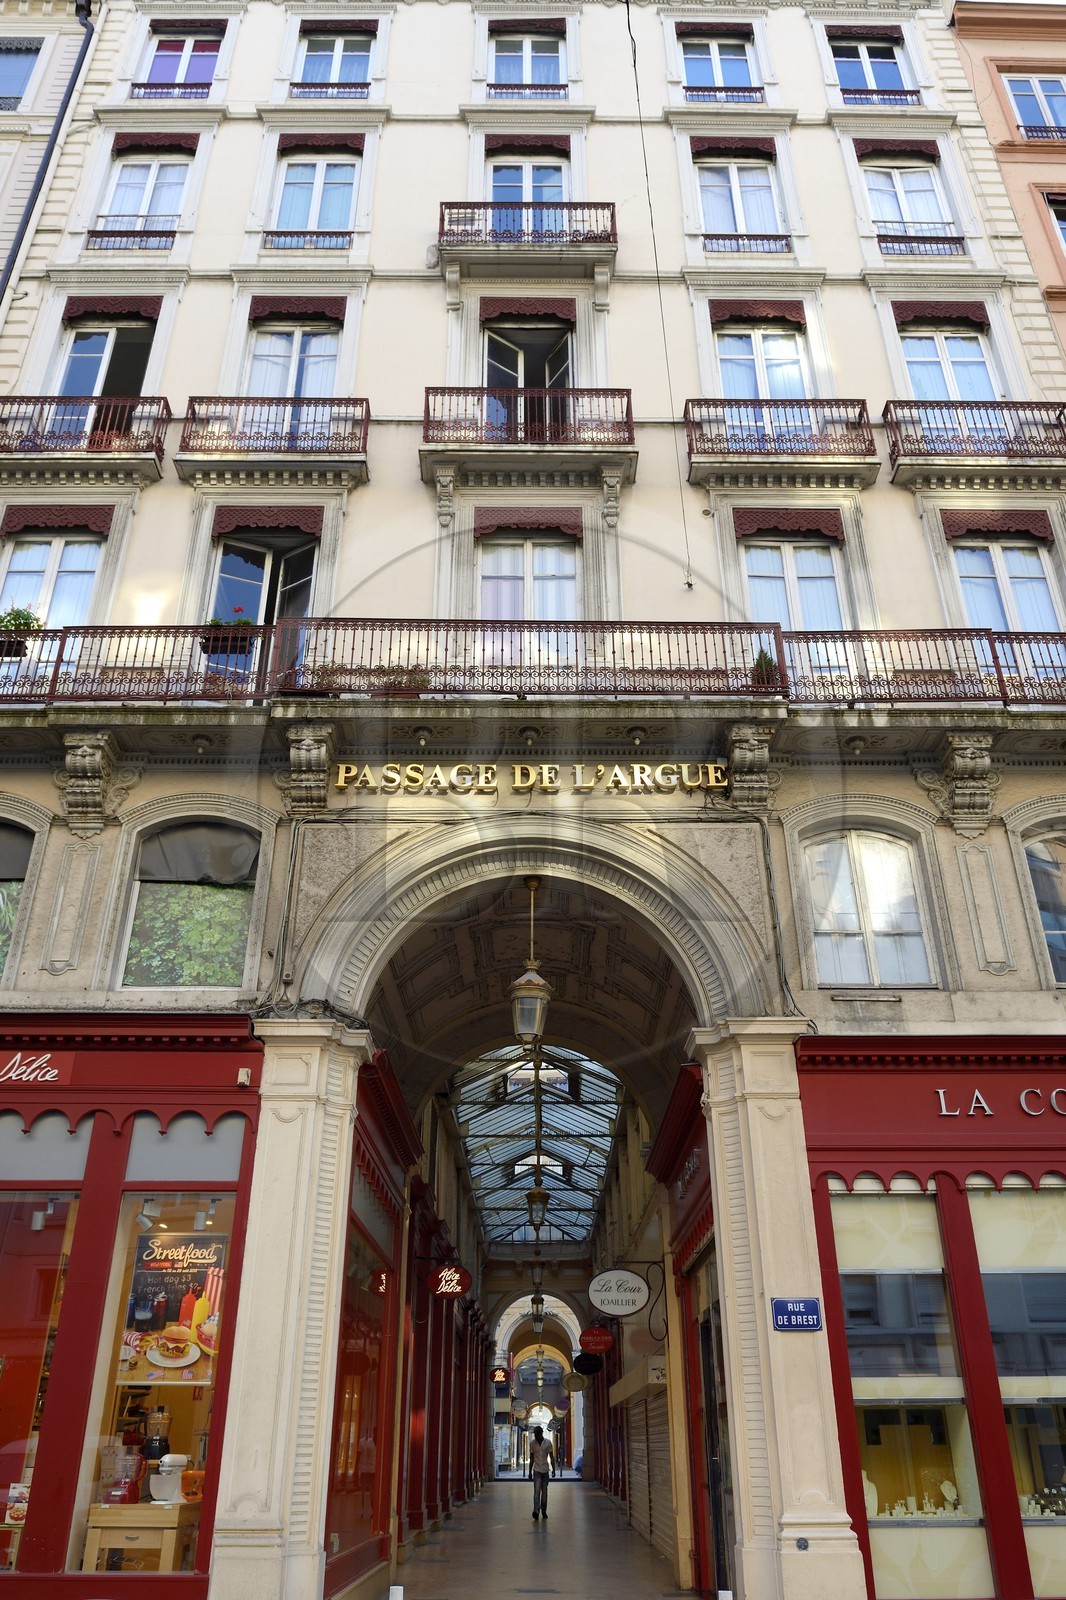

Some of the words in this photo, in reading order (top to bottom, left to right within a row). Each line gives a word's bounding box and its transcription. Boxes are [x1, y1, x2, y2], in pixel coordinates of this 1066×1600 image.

[335, 763, 498, 790] PASSAGE
[512, 763, 561, 790] DE
[572, 763, 728, 790] L'ARGUE
[0, 1051, 59, 1082] Délice
[935, 1088, 995, 1116] LA
[142, 1239, 222, 1267] Streetfood
[164, 1275, 179, 1284] dog
[438, 1267, 460, 1281] Alice
[435, 1280, 462, 1294] Délice
[593, 1279, 613, 1293] La
[616, 1280, 643, 1294] Cour
[600, 1298, 637, 1307] JOAILLIER
[787, 1303, 805, 1312] RUE
[777, 1315, 789, 1325] DE
[791, 1315, 817, 1325] BREST
